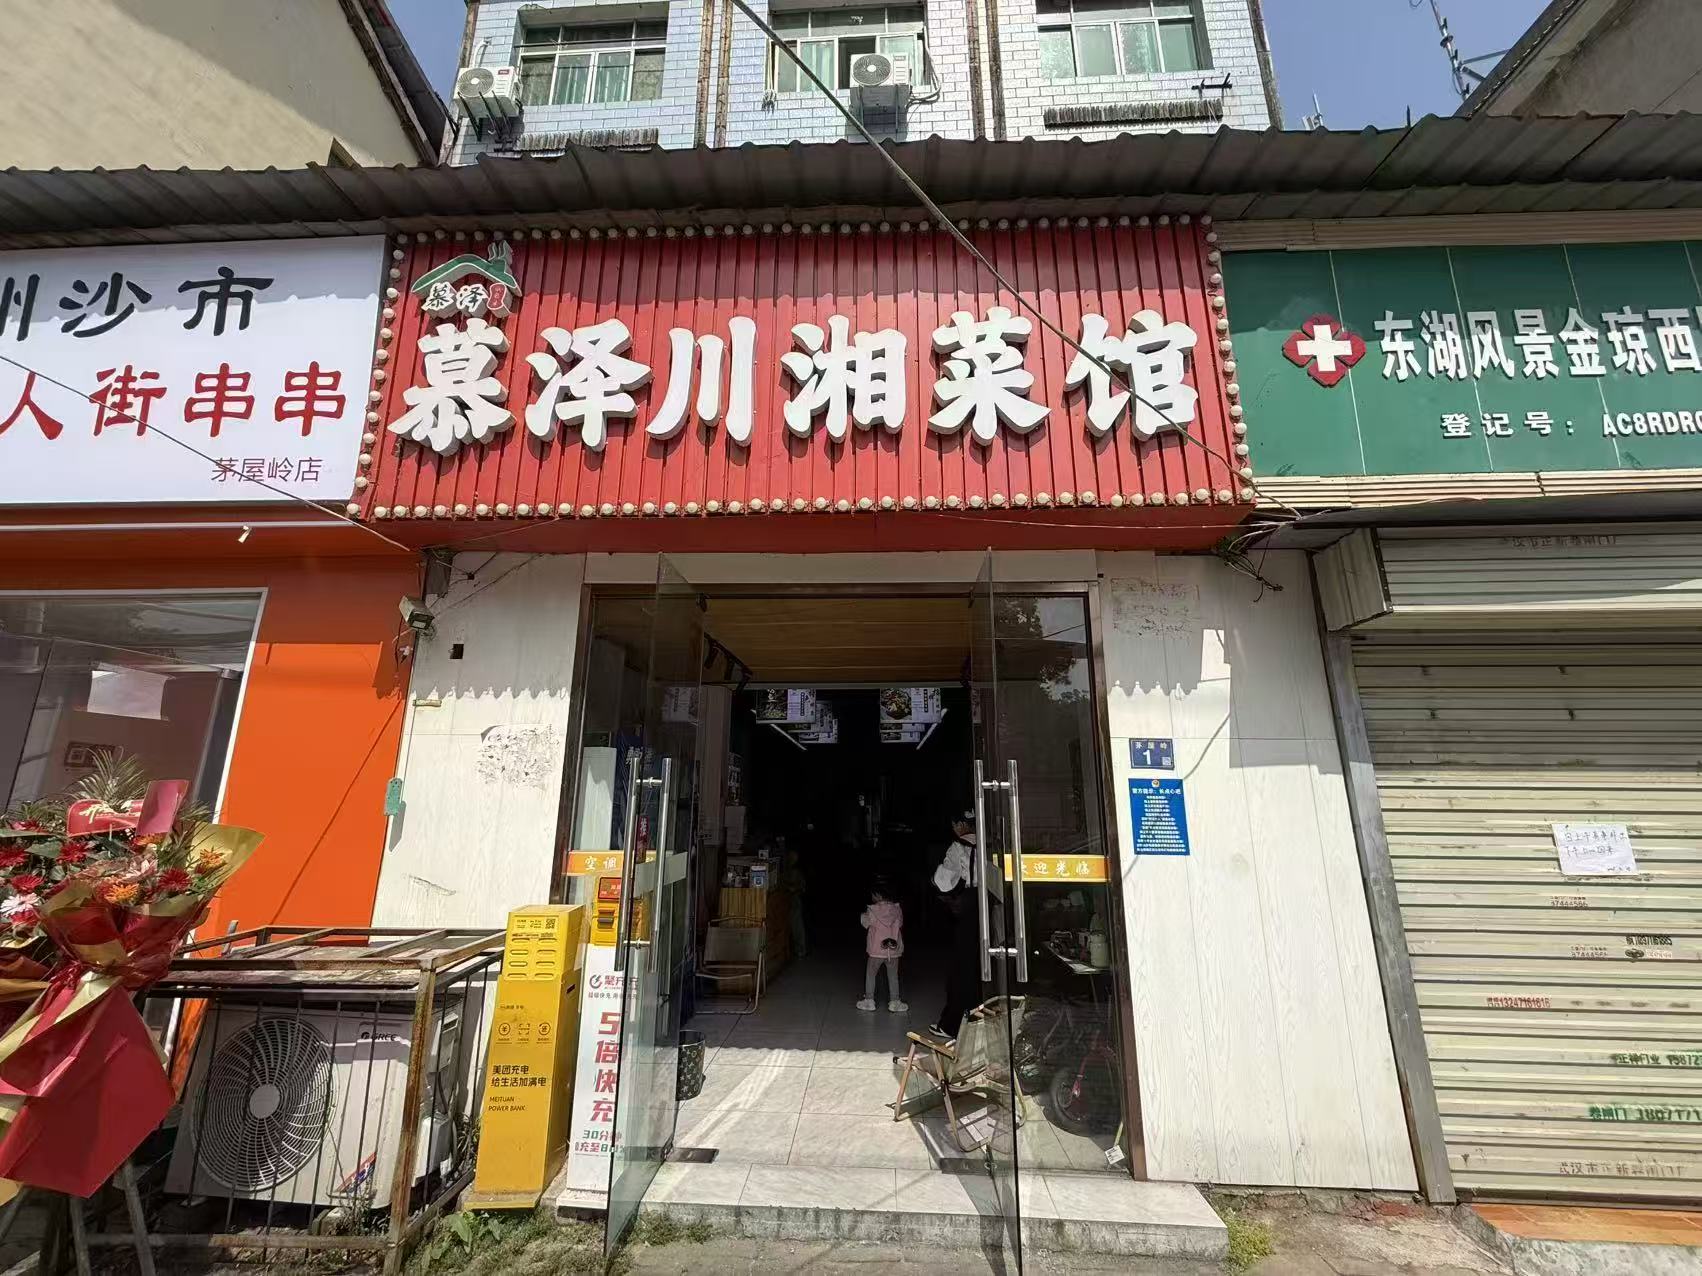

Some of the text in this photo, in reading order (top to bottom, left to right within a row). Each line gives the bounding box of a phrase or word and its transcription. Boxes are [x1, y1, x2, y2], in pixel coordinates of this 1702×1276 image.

[424, 282, 485, 311] 慕泽
[1374, 306, 1702, 381] 东湖风景金琼西
[388, 306, 1199, 456] 慕泽川湘菜馆
[0, 361, 346, 440] 人街串串
[211, 456, 323, 483] 茅屋岭店
[1142, 749, 1152, 765] 1
[584, 856, 618, 871] 空调
[493, 1064, 530, 1075] 美团充电
[590, 1011, 622, 1123] 5倍快充
[491, 1077, 548, 1088] 给生活加满电
